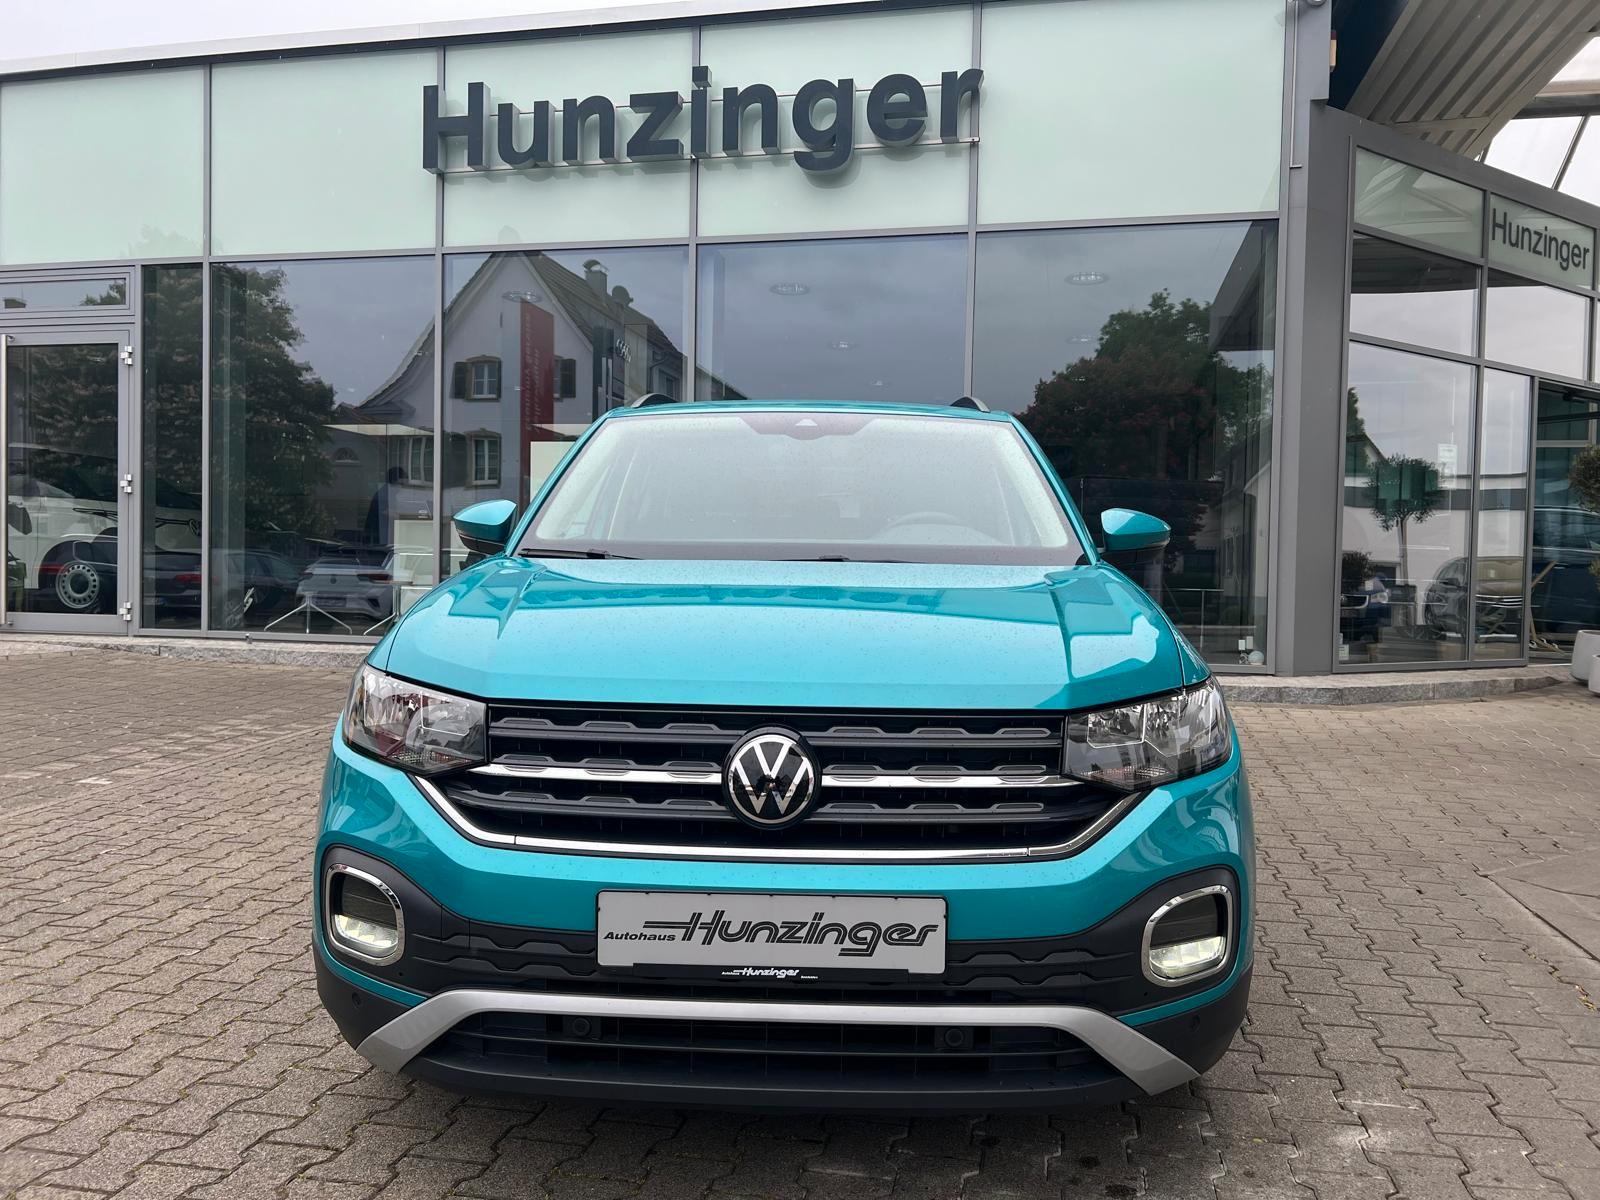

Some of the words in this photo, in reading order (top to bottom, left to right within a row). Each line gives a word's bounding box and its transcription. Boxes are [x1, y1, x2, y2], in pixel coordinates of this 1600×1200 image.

[423, 65, 984, 174] Hunzinger
[1492, 208, 1590, 271] Hunzinger
[603, 931, 676, 943] Autohaus
[642, 910, 940, 957] Hunzinger
[734, 967, 800, 978] Hunzinger
